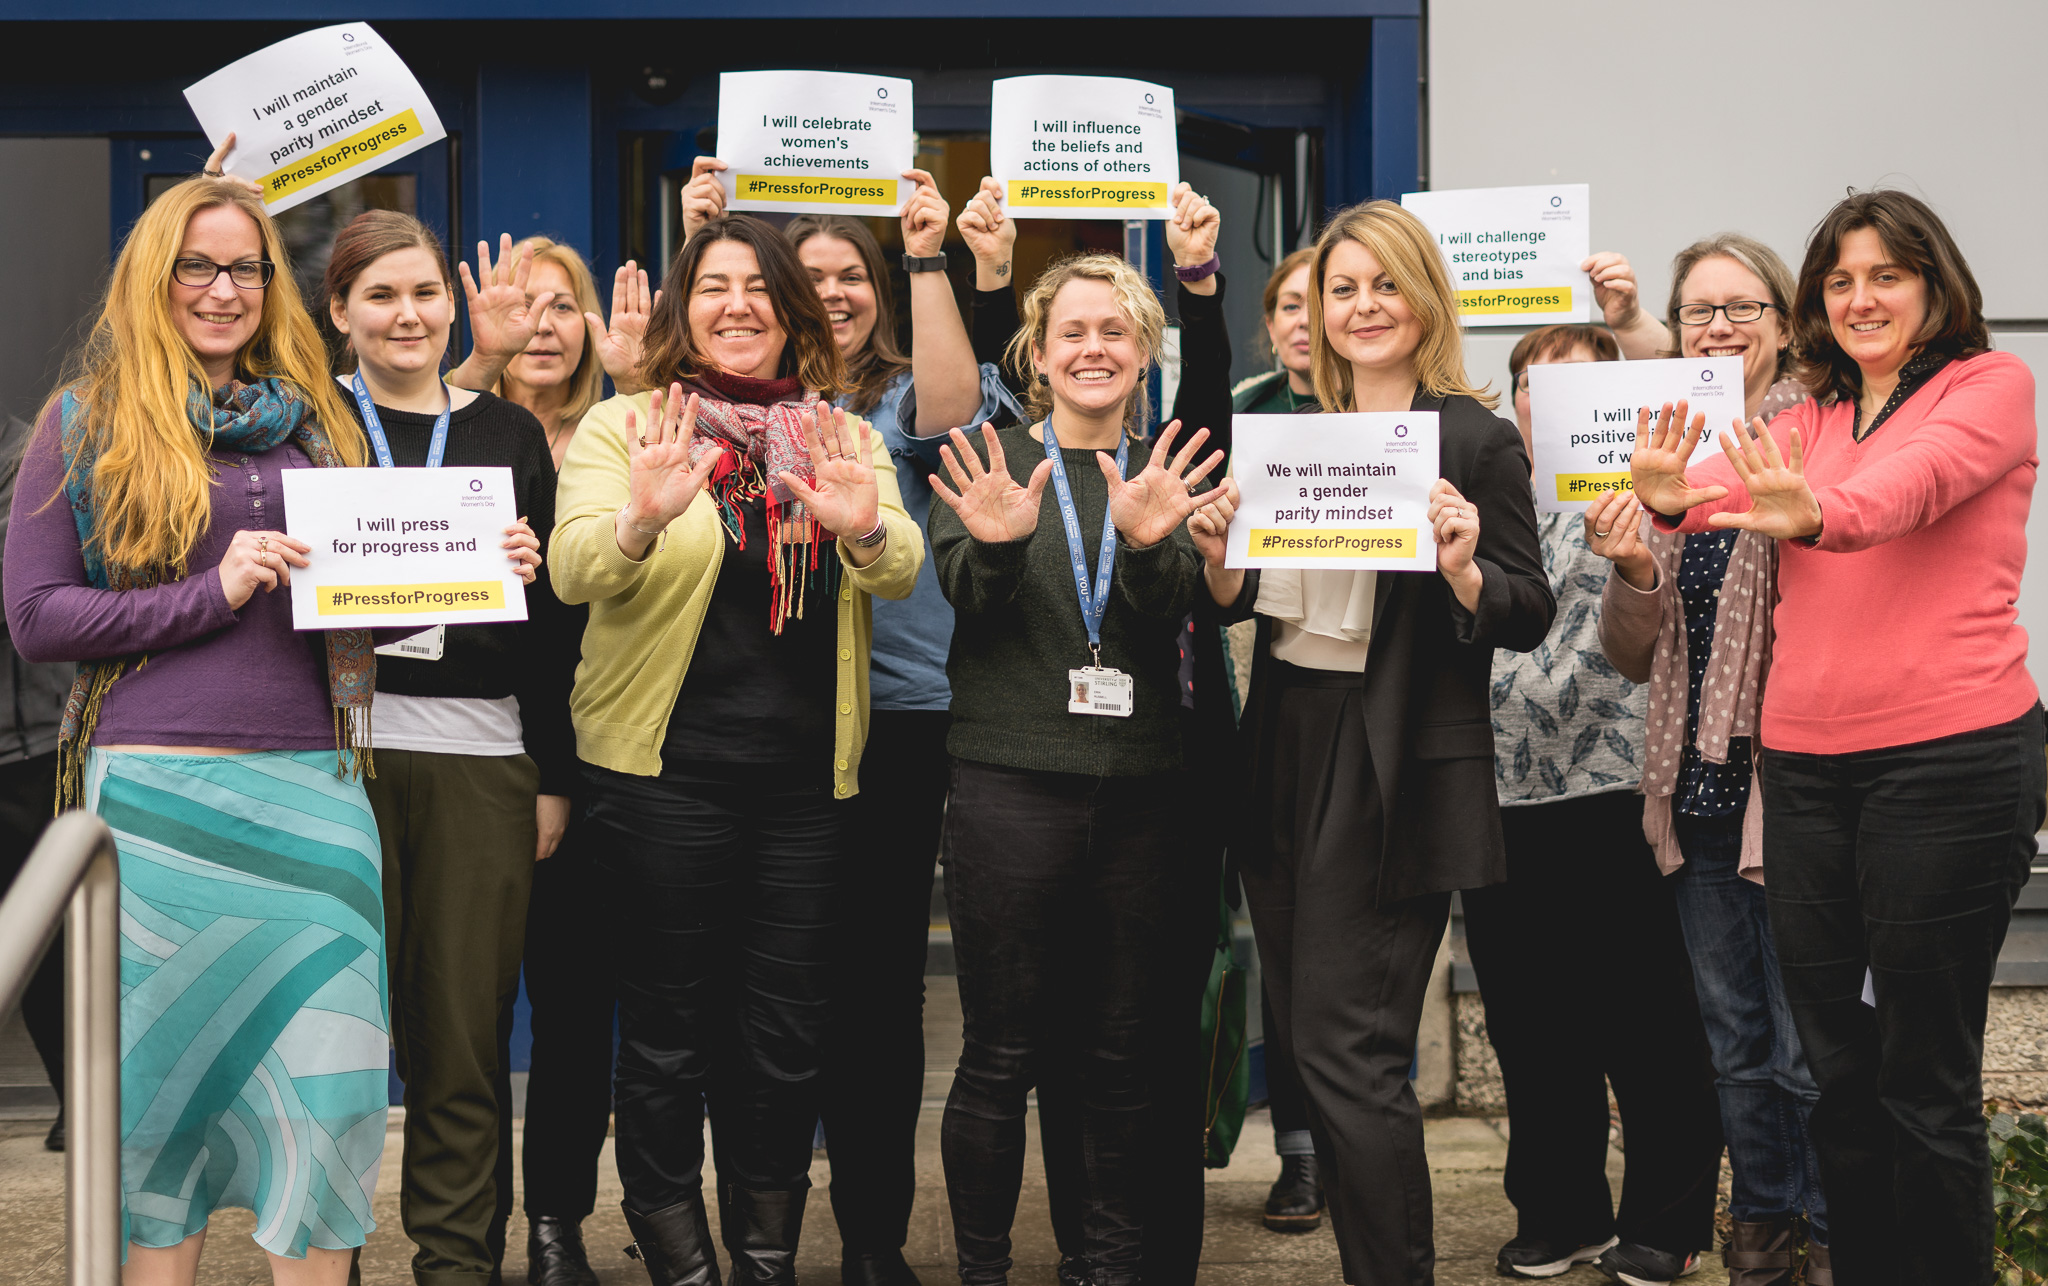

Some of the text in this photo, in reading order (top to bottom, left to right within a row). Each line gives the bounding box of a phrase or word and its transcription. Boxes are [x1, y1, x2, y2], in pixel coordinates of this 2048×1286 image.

[253, 67, 358, 121] I will maintain
[284, 92, 348, 131] a gender
[763, 115, 871, 130] I will celebrate
[1034, 120, 1140, 134] I will influence
[270, 100, 384, 164] parity mindset
[782, 137, 848, 149] women's
[1032, 140, 1142, 153] the beliefs and
[271, 122, 407, 191] #PressforProgress
[764, 154, 868, 169] achievements
[1024, 159, 1150, 172] actions of others
[749, 181, 884, 198] #PressforProgress
[1021, 187, 1155, 202] #PressforProgress
[1440, 231, 1546, 244] I will challenge
[1453, 251, 1536, 264] stereotypes
[1463, 268, 1523, 280] and bias
[361, 398, 372, 413] YOU
[1594, 410, 1598, 422] I
[1604, 408, 1630, 421] will
[1571, 430, 1635, 447] positive
[1598, 451, 1614, 464] of
[1267, 463, 1396, 476] We will maintain
[1300, 484, 1368, 500] a gender
[1064, 504, 1074, 520] YOU
[1276, 506, 1393, 523] parity mindset
[357, 518, 449, 534] I will press
[332, 538, 476, 556] for progress and
[1263, 536, 1402, 551] #PressforProgress
[1079, 576, 1089, 595] YOU
[333, 591, 488, 605] #PressforProgress
